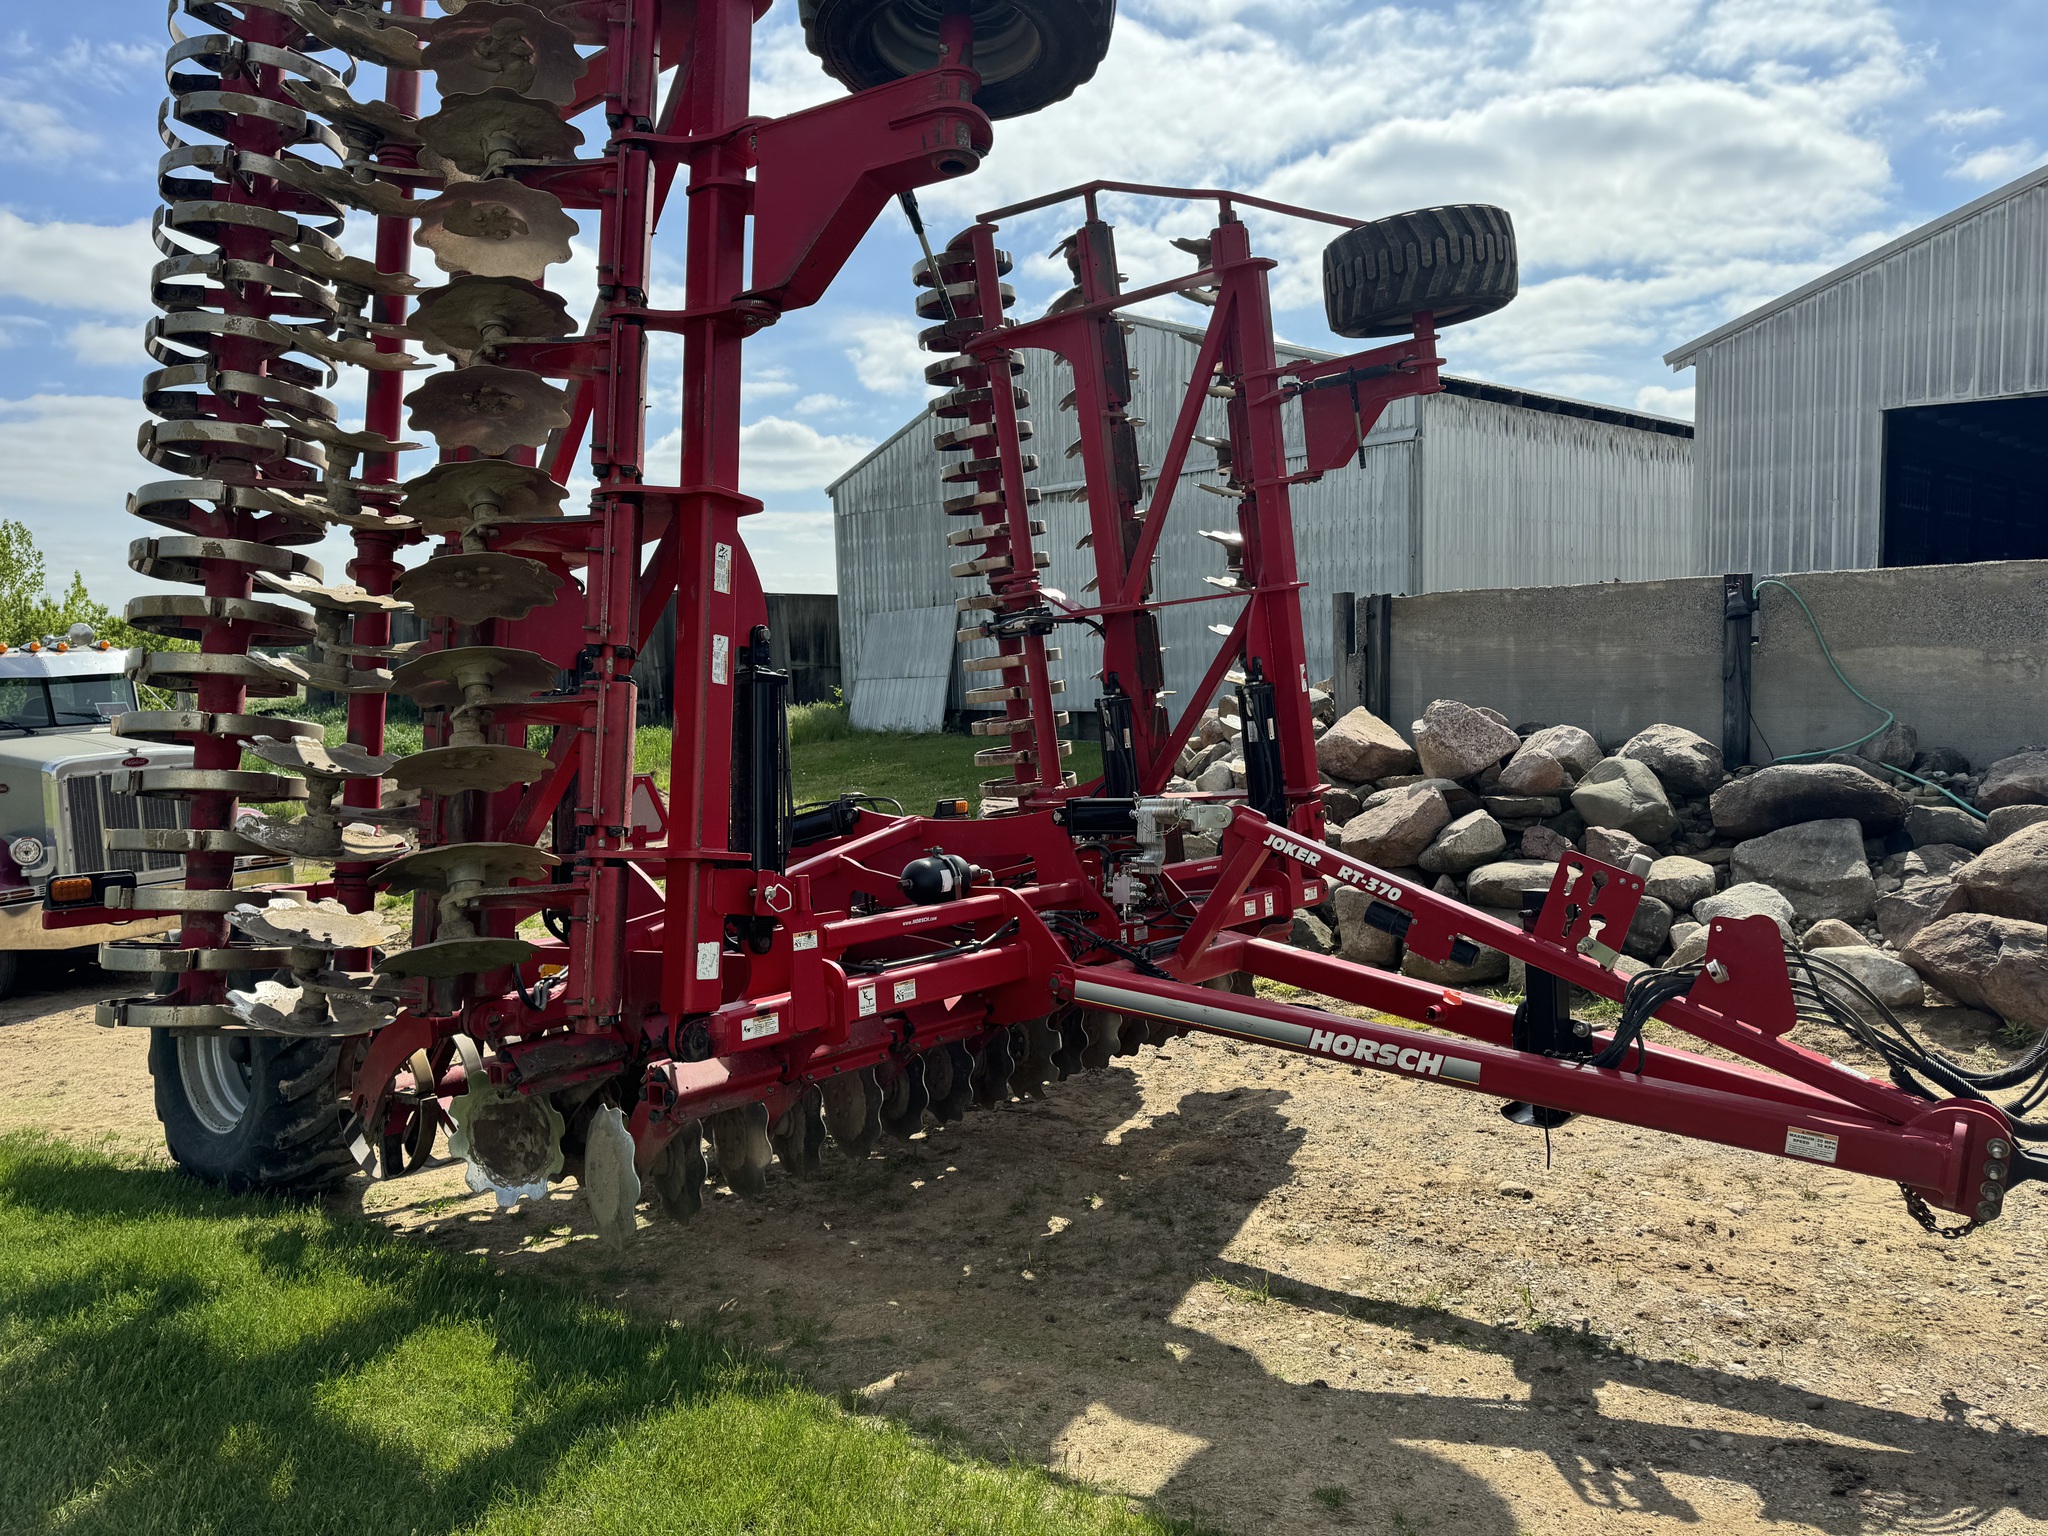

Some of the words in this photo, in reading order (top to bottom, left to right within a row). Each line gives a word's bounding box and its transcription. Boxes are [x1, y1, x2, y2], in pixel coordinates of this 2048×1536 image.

[1263, 834, 1322, 867] JOKER
[1337, 865, 1402, 901] RT-370
[1309, 1028, 1445, 1076] HORSCH
[1789, 1133, 1815, 1141] MAXIMUM
